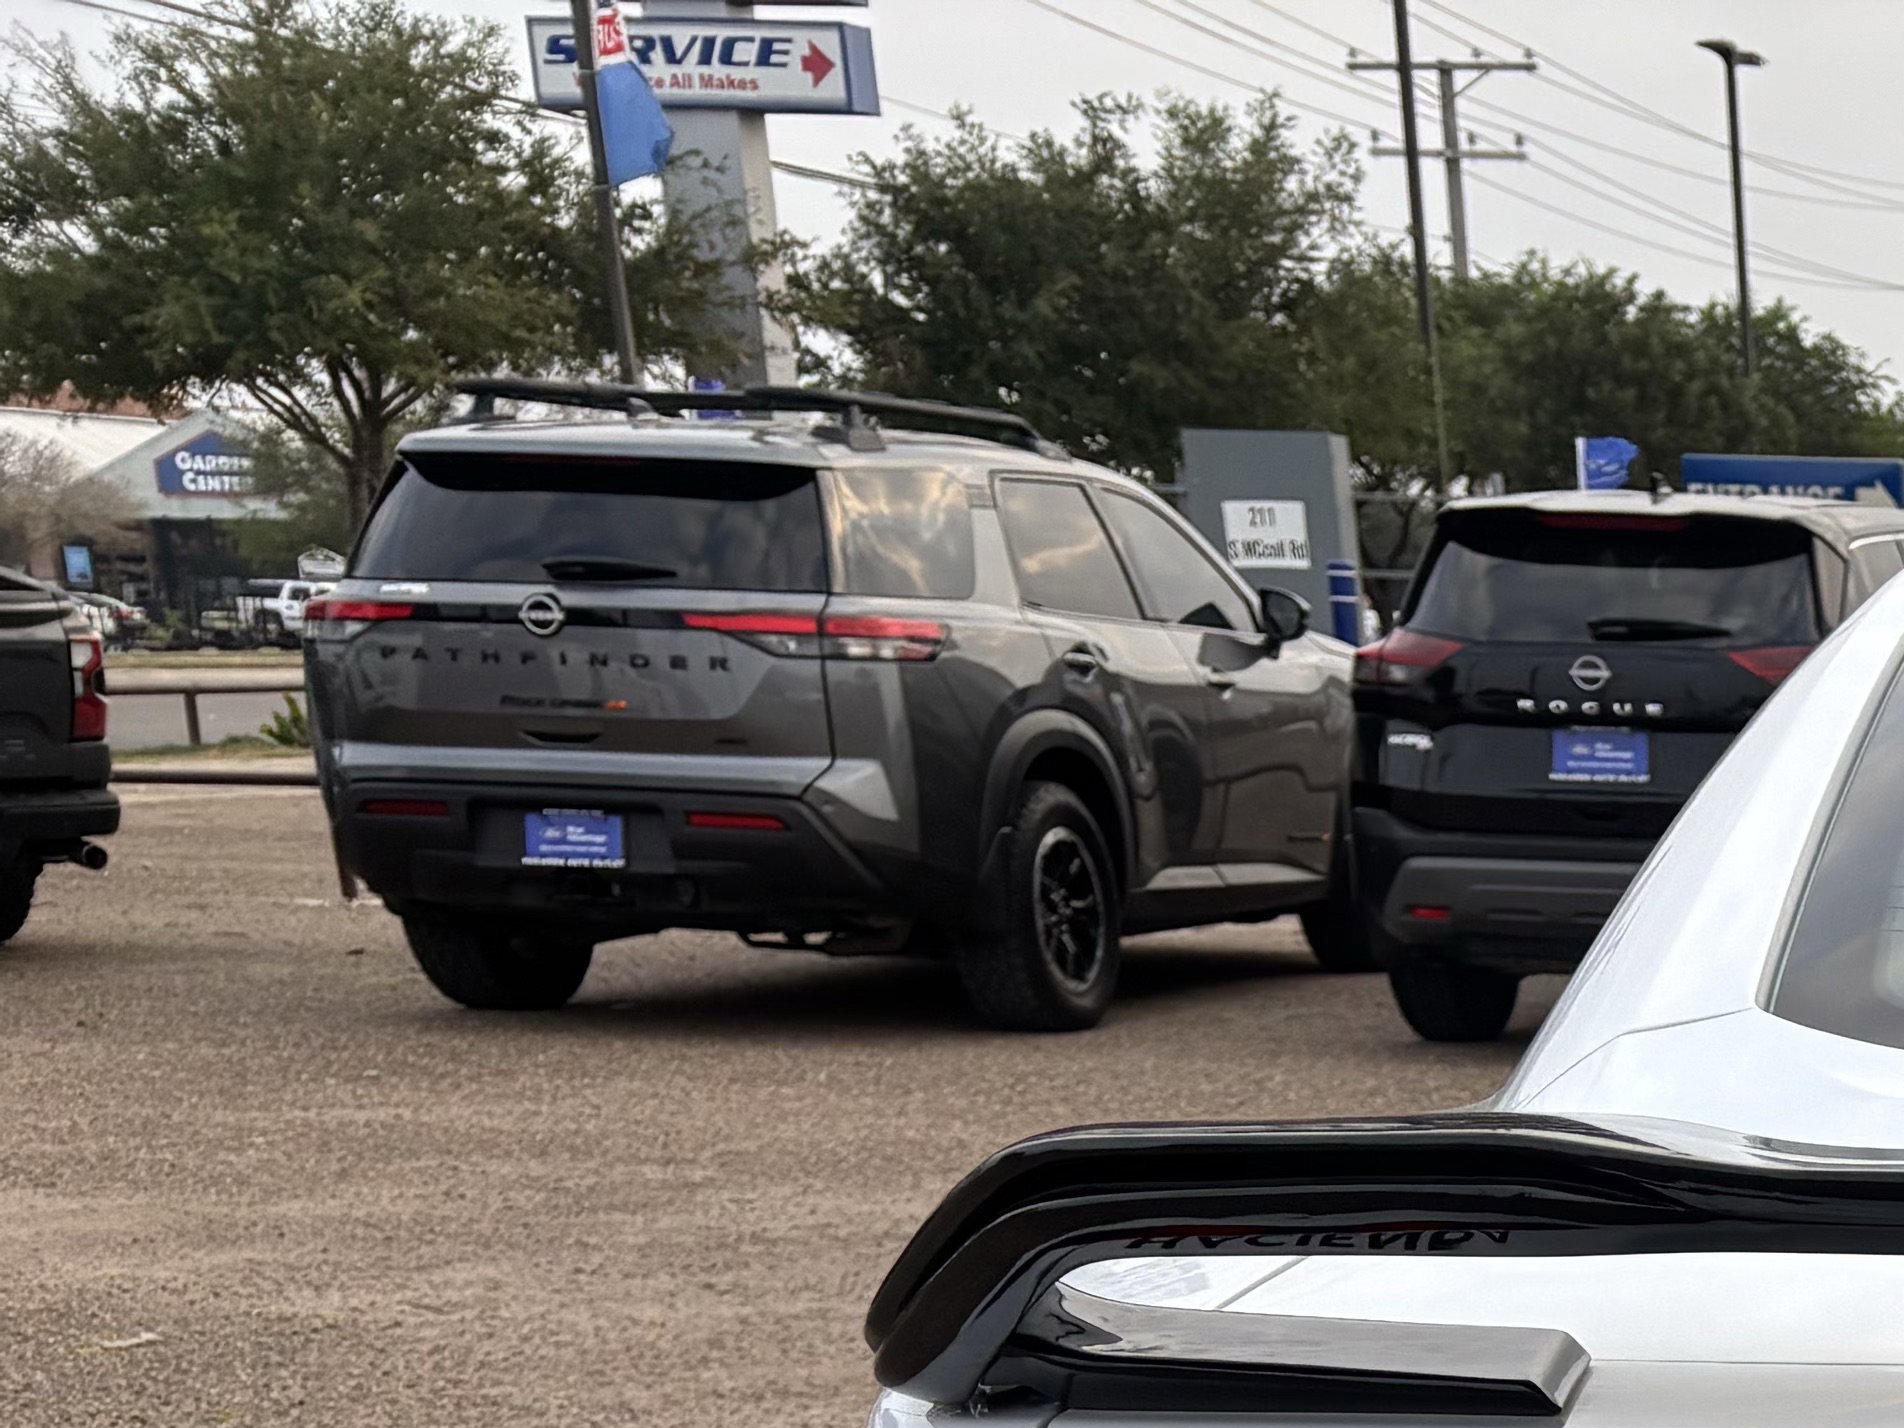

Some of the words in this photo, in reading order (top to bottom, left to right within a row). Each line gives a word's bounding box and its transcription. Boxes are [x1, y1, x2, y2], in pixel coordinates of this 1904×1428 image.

[543, 34, 794, 67] SRVICE
[670, 73, 692, 88] All
[699, 74, 760, 92] Makes
[379, 646, 731, 672] PATHFINDER
[1516, 698, 1664, 717] ROGUE
